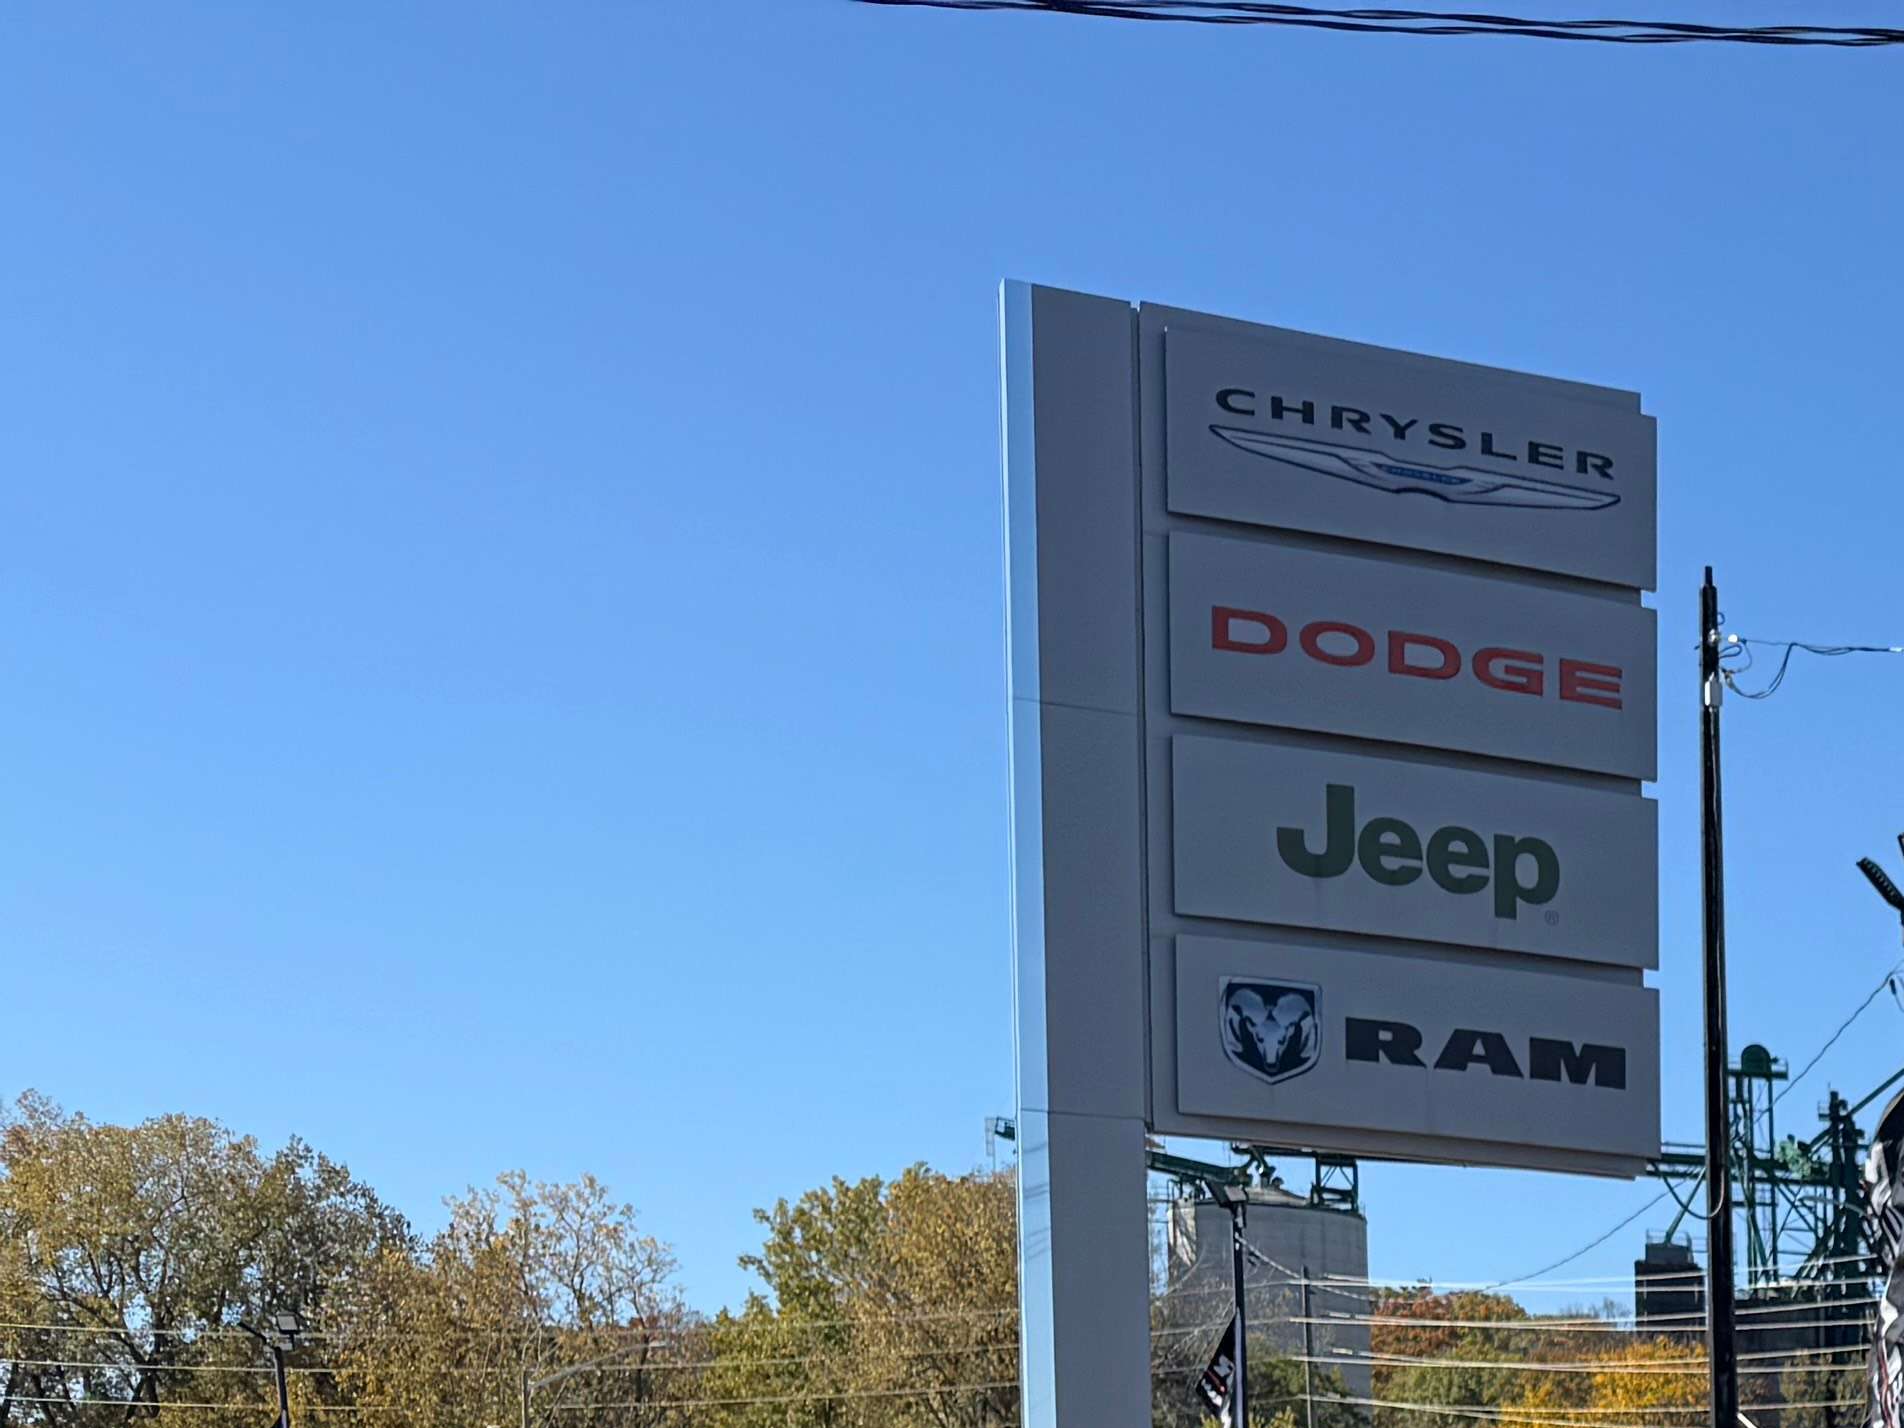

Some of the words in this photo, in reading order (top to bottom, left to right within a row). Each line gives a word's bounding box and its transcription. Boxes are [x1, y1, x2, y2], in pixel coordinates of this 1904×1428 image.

[1215, 388, 1614, 481] CHRYSLER
[1211, 606, 1623, 710] DODGE
[1277, 784, 1560, 920] Jeep
[1345, 1017, 1626, 1091] RAM
